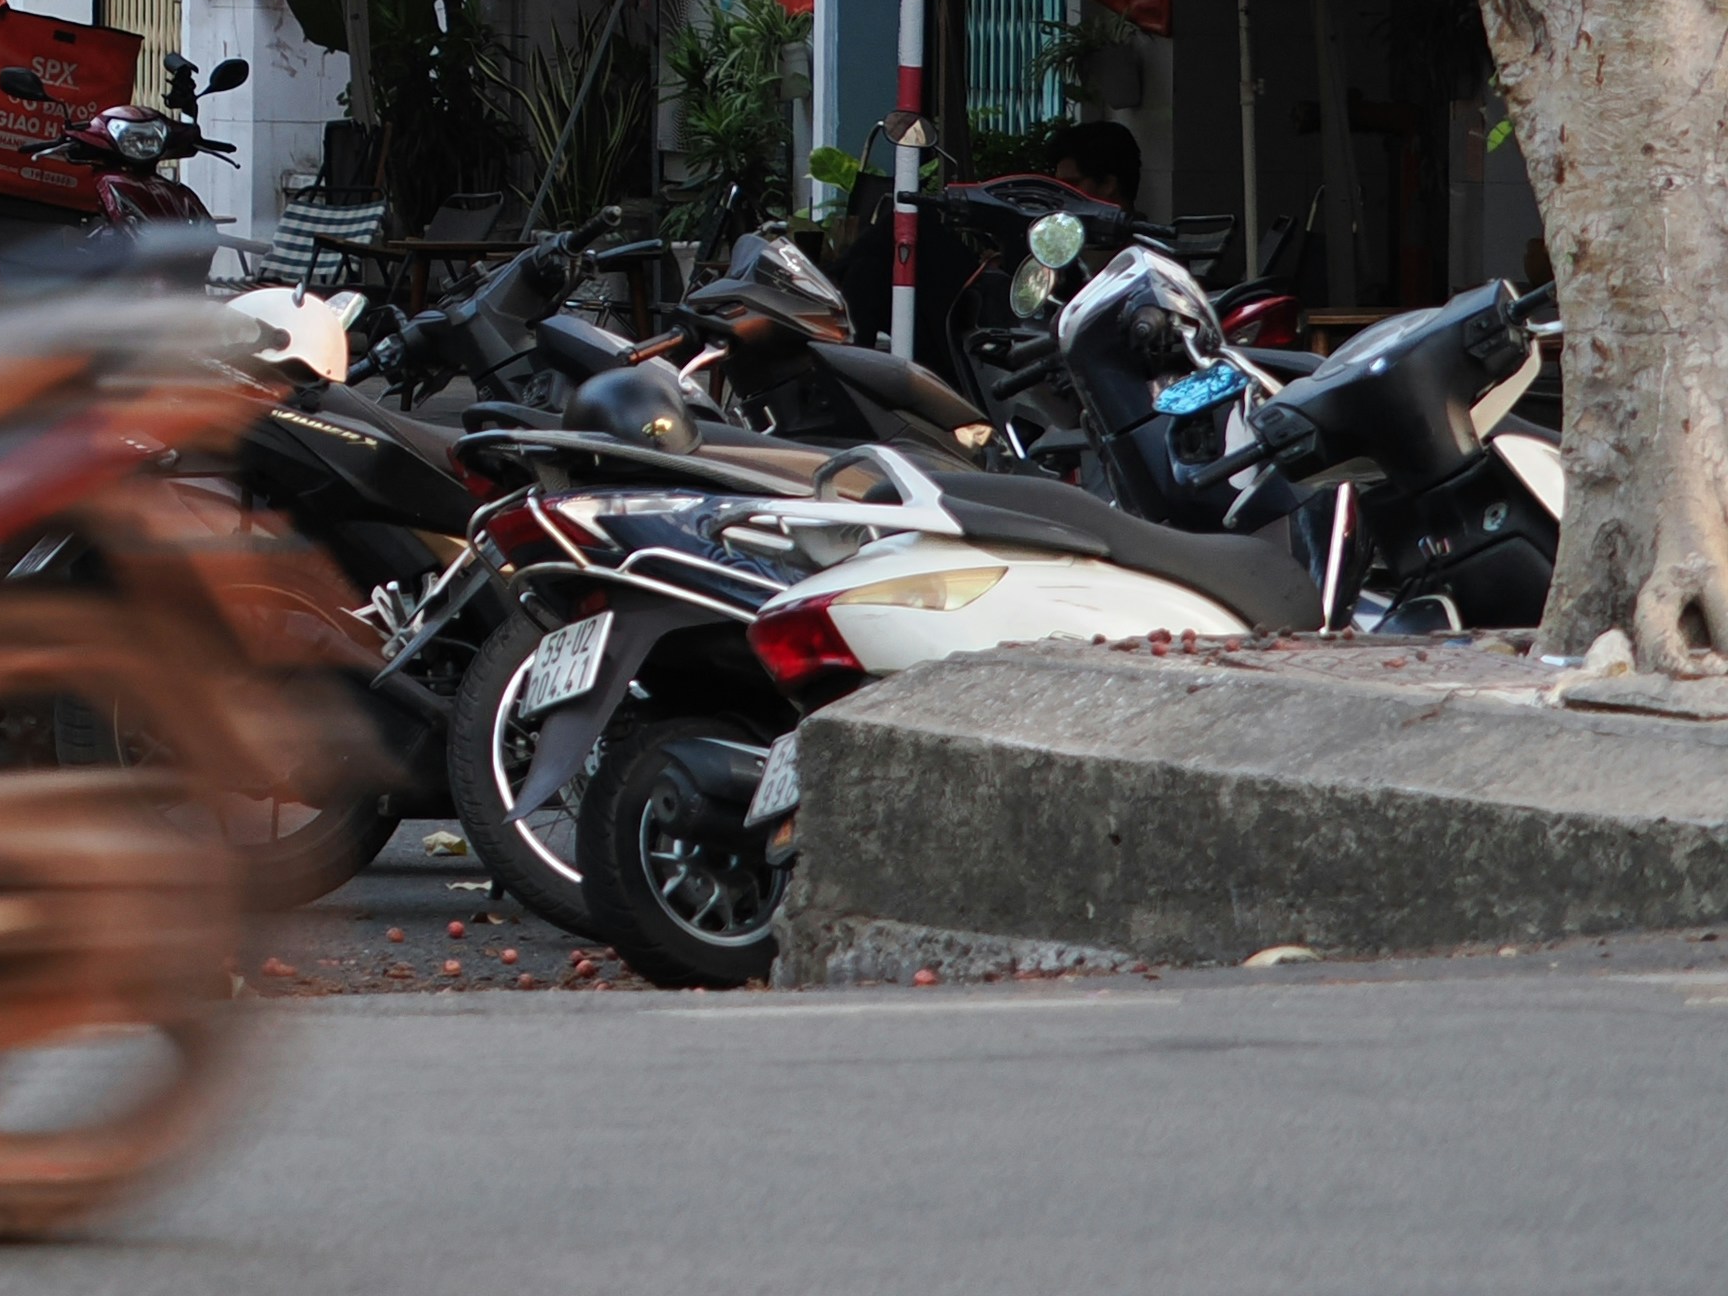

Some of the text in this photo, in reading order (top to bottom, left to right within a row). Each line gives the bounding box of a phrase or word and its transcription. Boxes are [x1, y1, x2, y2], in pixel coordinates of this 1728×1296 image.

[32, 56, 77, 85] SPX
[542, 619, 597, 668] 59-U2
[528, 654, 590, 709] 204.41
